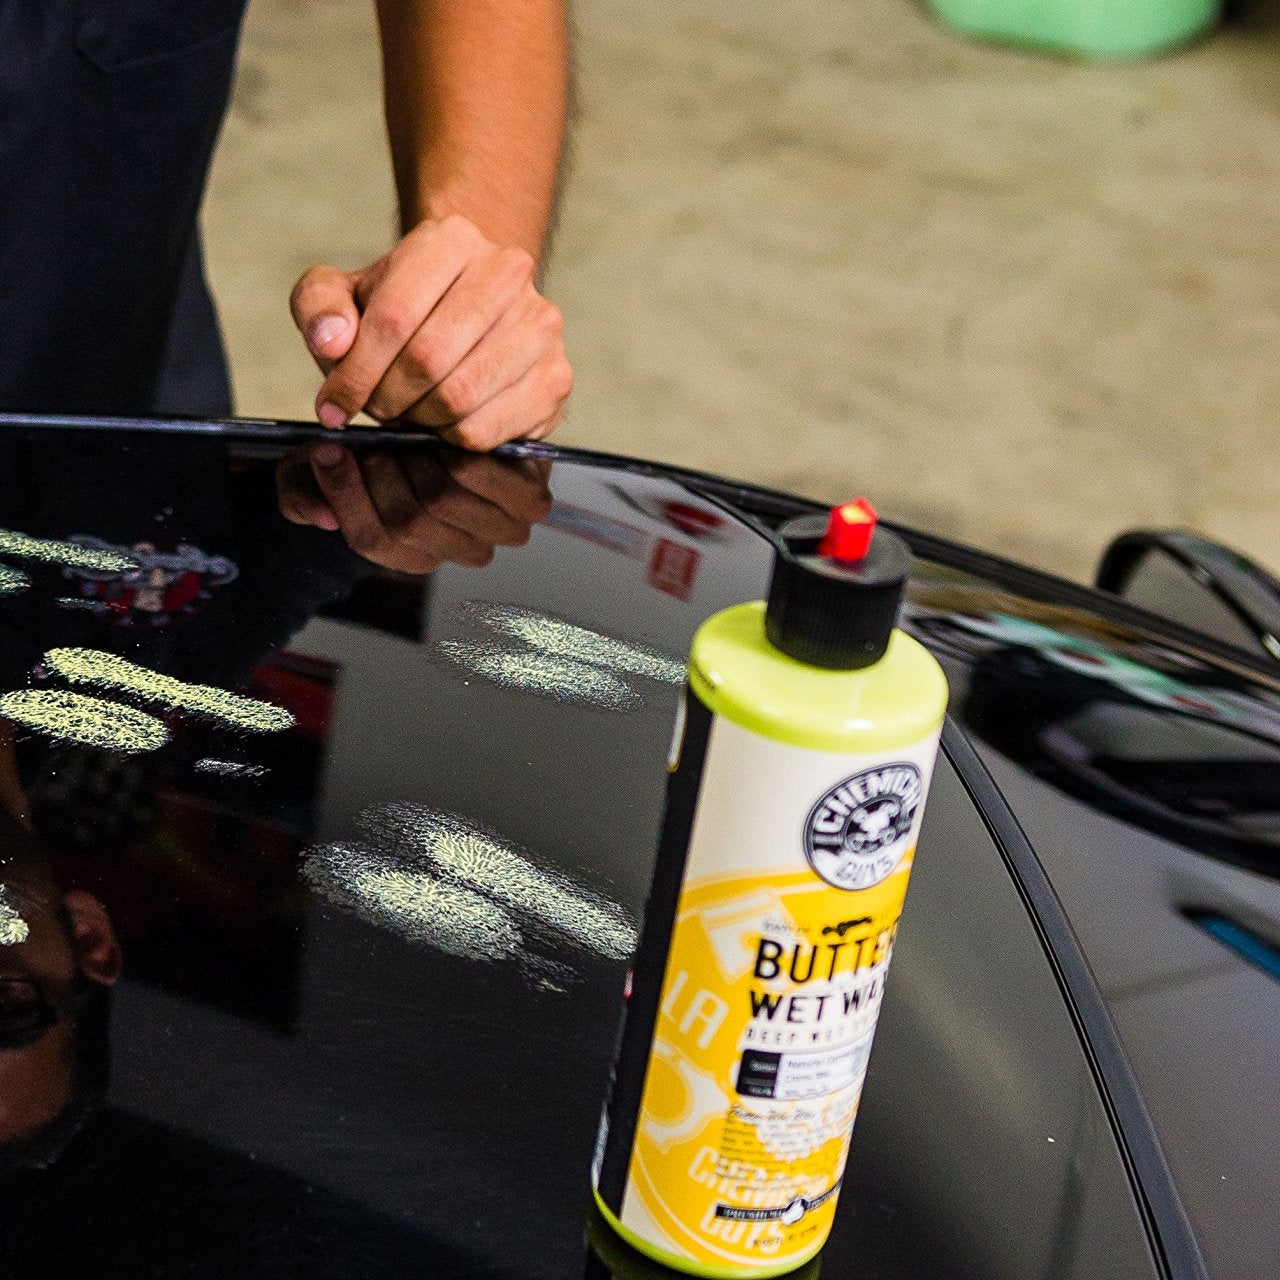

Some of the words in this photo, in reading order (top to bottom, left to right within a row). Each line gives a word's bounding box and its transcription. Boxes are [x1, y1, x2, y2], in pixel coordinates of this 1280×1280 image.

[753, 926, 894, 984] BUTTE
[750, 990, 832, 1024] WET
[843, 977, 887, 1015] WA
